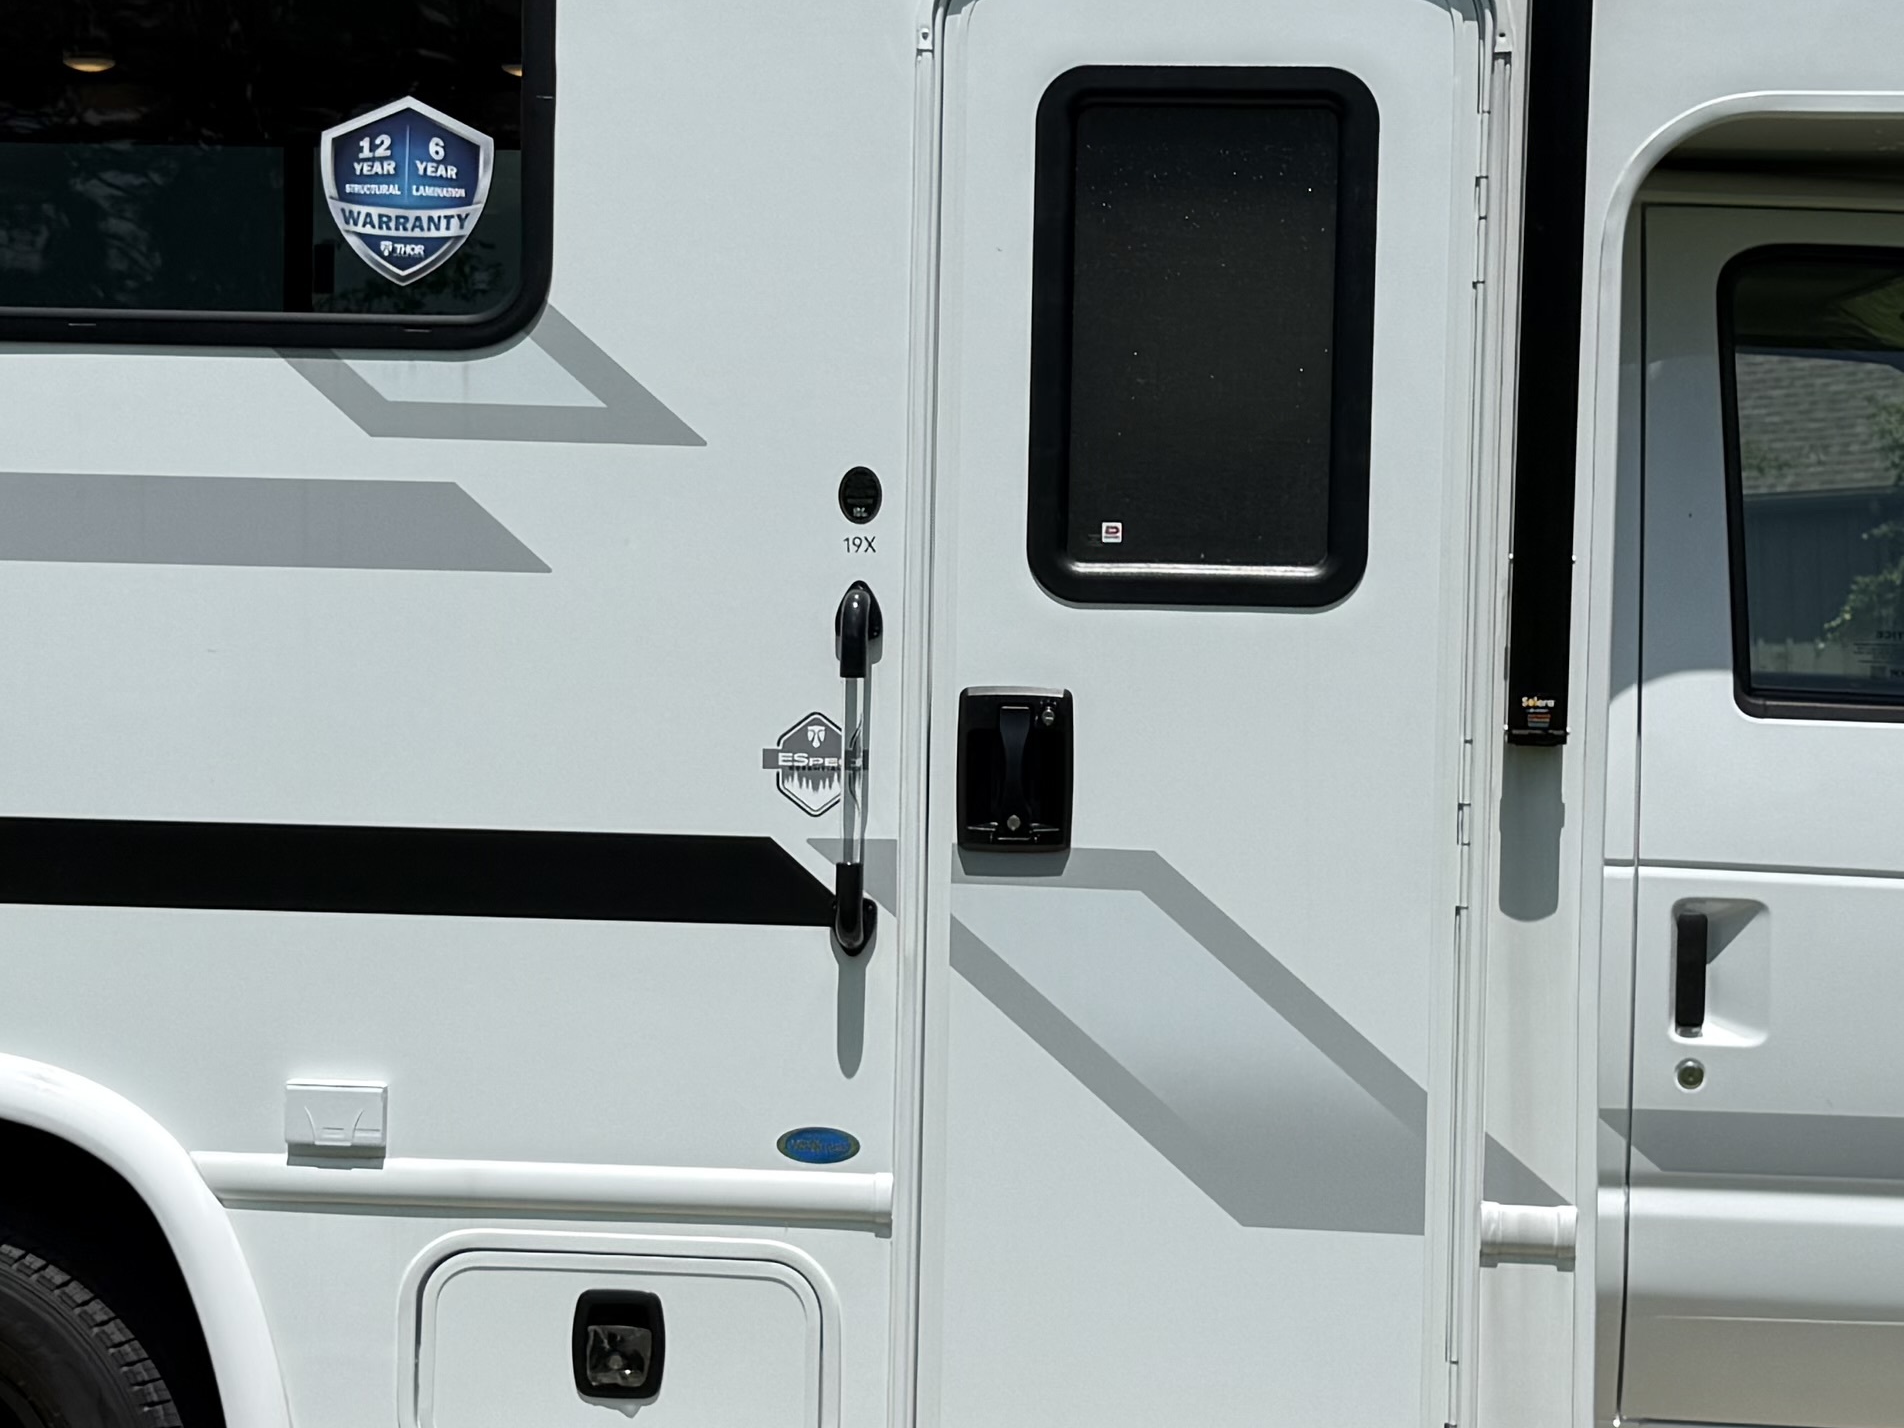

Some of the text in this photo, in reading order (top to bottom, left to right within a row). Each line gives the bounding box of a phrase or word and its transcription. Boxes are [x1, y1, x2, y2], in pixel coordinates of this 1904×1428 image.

[358, 134, 392, 159] 12
[428, 137, 445, 161] 6
[354, 160, 395, 175] YEAR
[415, 160, 457, 178] YEAR
[345, 183, 401, 195] STRUCTURAL
[341, 208, 470, 232] WARRANTY
[393, 243, 425, 258] THOR
[843, 535, 877, 553] 19X
